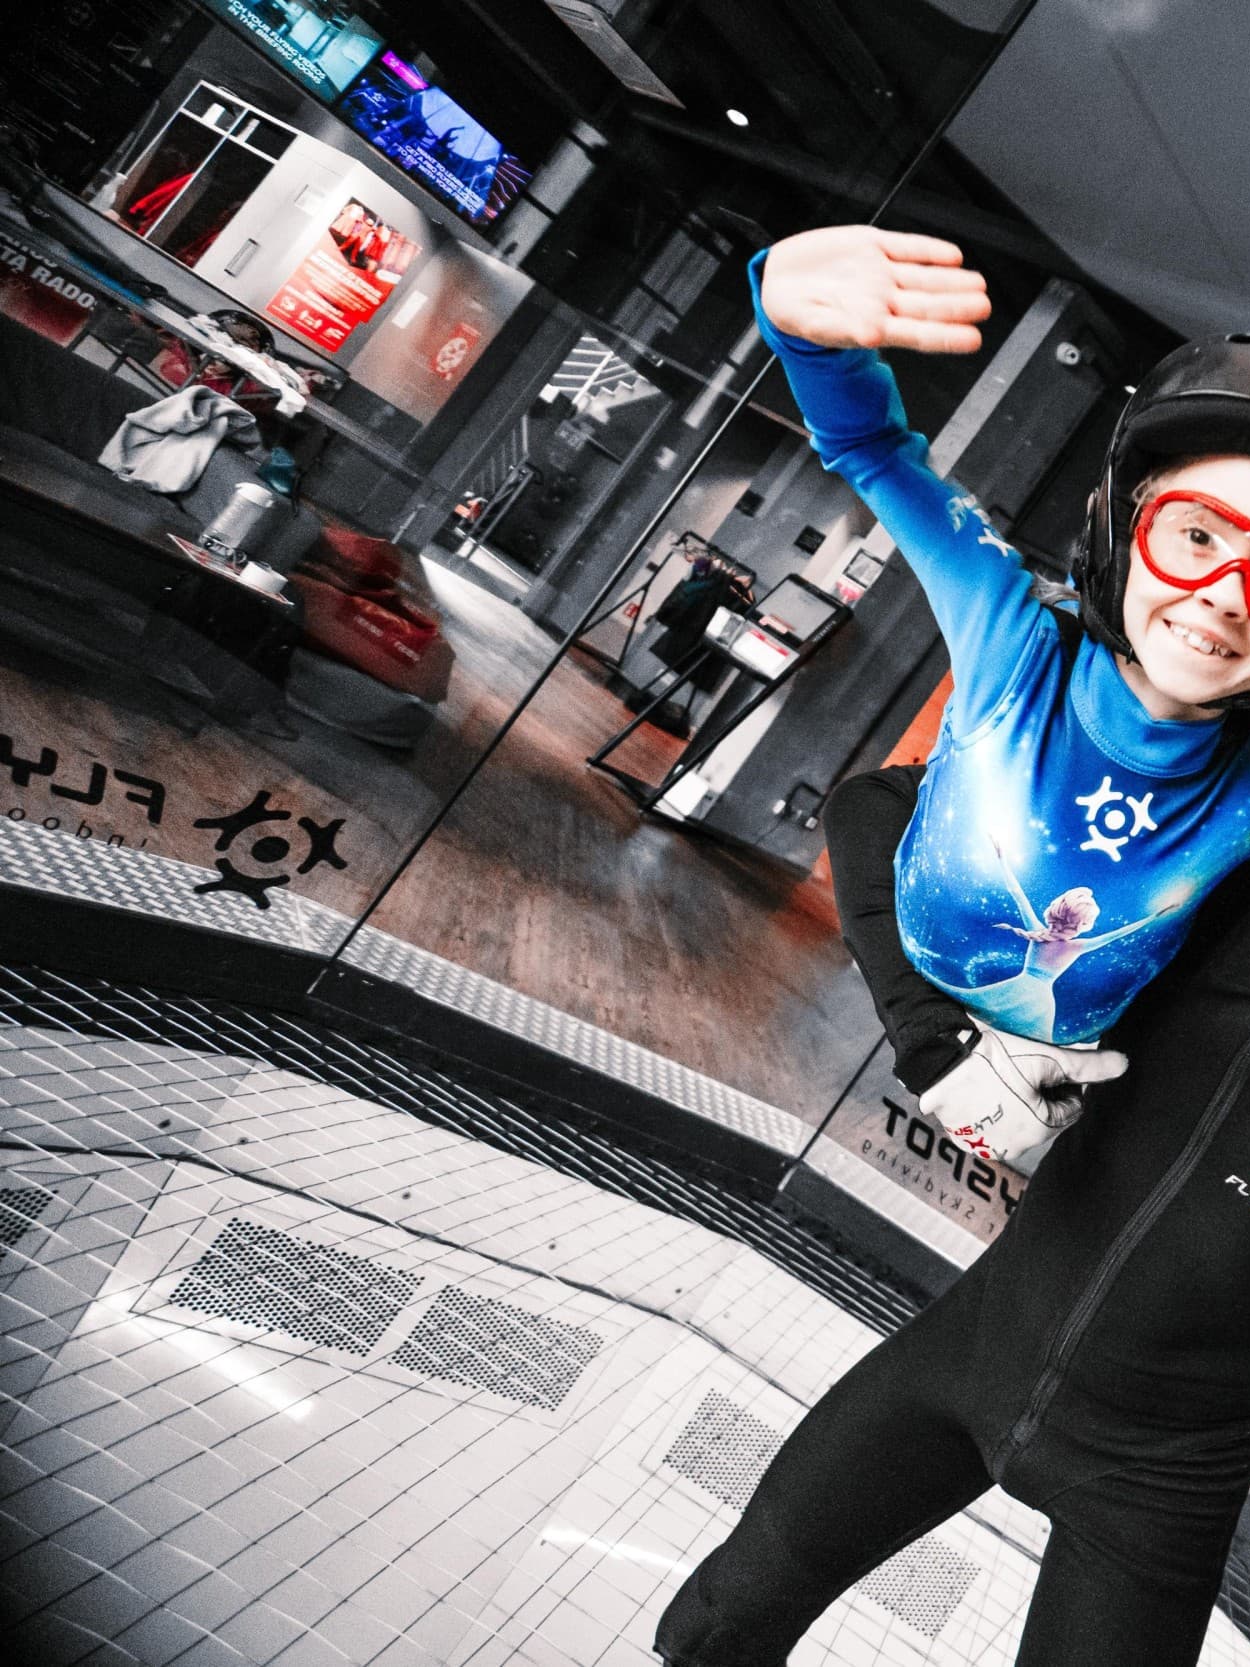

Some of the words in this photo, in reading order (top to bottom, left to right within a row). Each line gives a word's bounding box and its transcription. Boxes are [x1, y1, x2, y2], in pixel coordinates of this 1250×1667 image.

[228, 5, 240, 16] IN
[240, 13, 257, 31] THE
[256, 28, 293, 61] BRIEFING
[292, 58, 321, 84] ROOMS
[247, 11, 271, 33] YOUR
[270, 30, 298, 56] FLYING
[298, 53, 326, 80] VIDEOS
[404, 145, 419, 157] GET
[435, 178, 454, 194] YOUR
